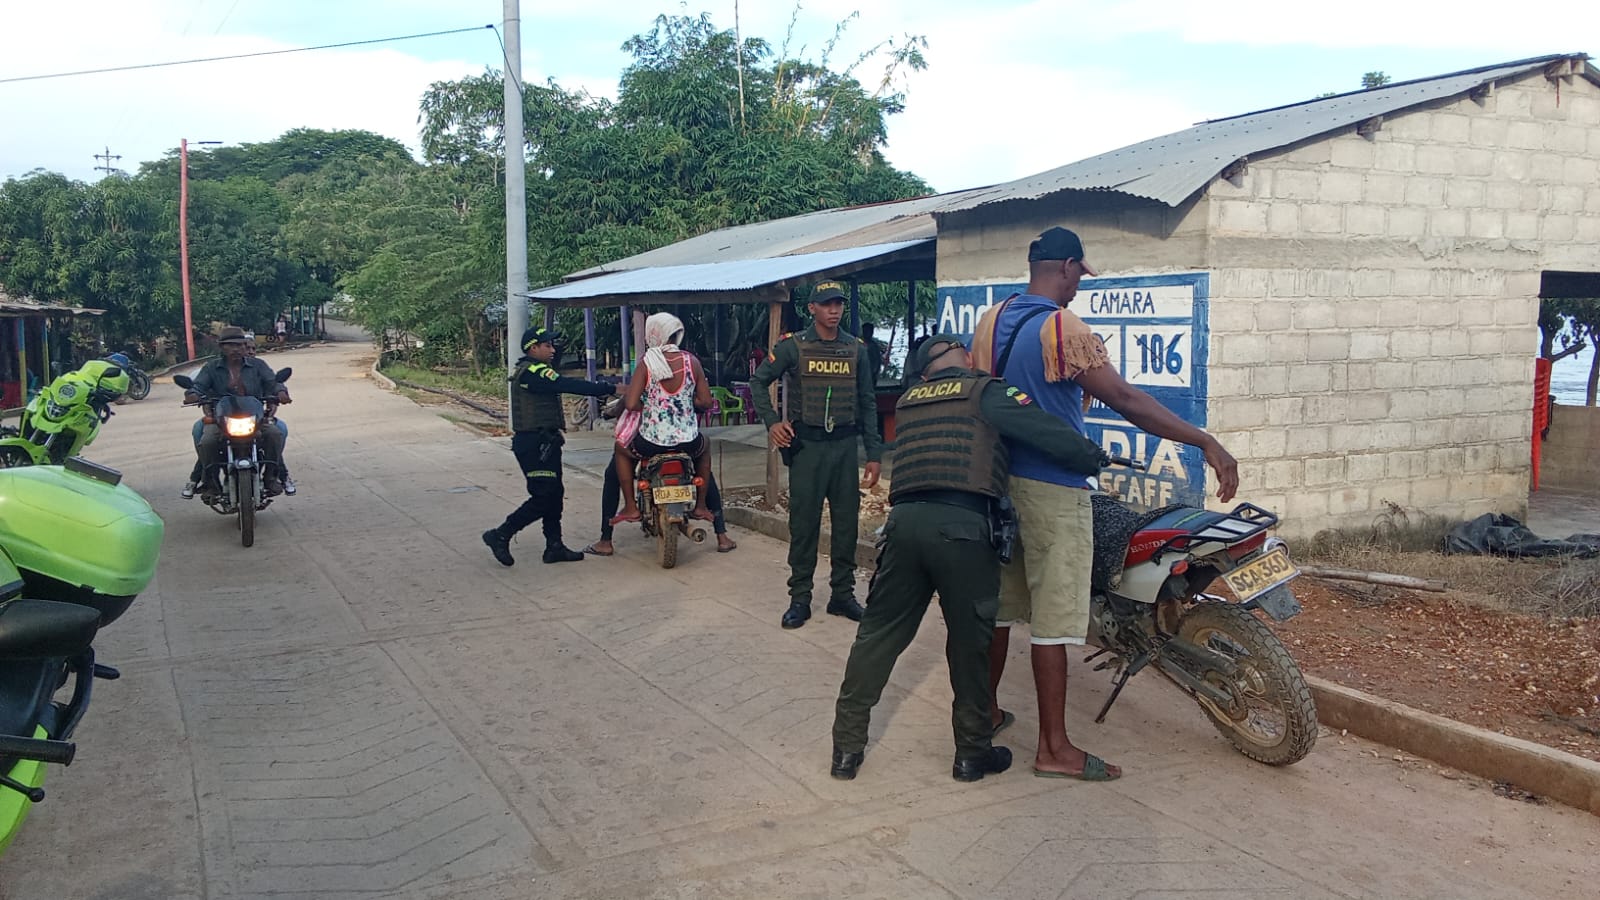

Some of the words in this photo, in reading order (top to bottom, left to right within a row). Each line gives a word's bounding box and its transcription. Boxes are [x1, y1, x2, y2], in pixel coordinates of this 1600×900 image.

[1090, 290, 1155, 314] CÁMARA
[808, 360, 850, 374] POLICIA
[1136, 333, 1183, 374] 106
[907, 382, 962, 400] POLICIA
[1085, 429, 1187, 480] DIA
[1099, 472, 1173, 507] SCAFF
